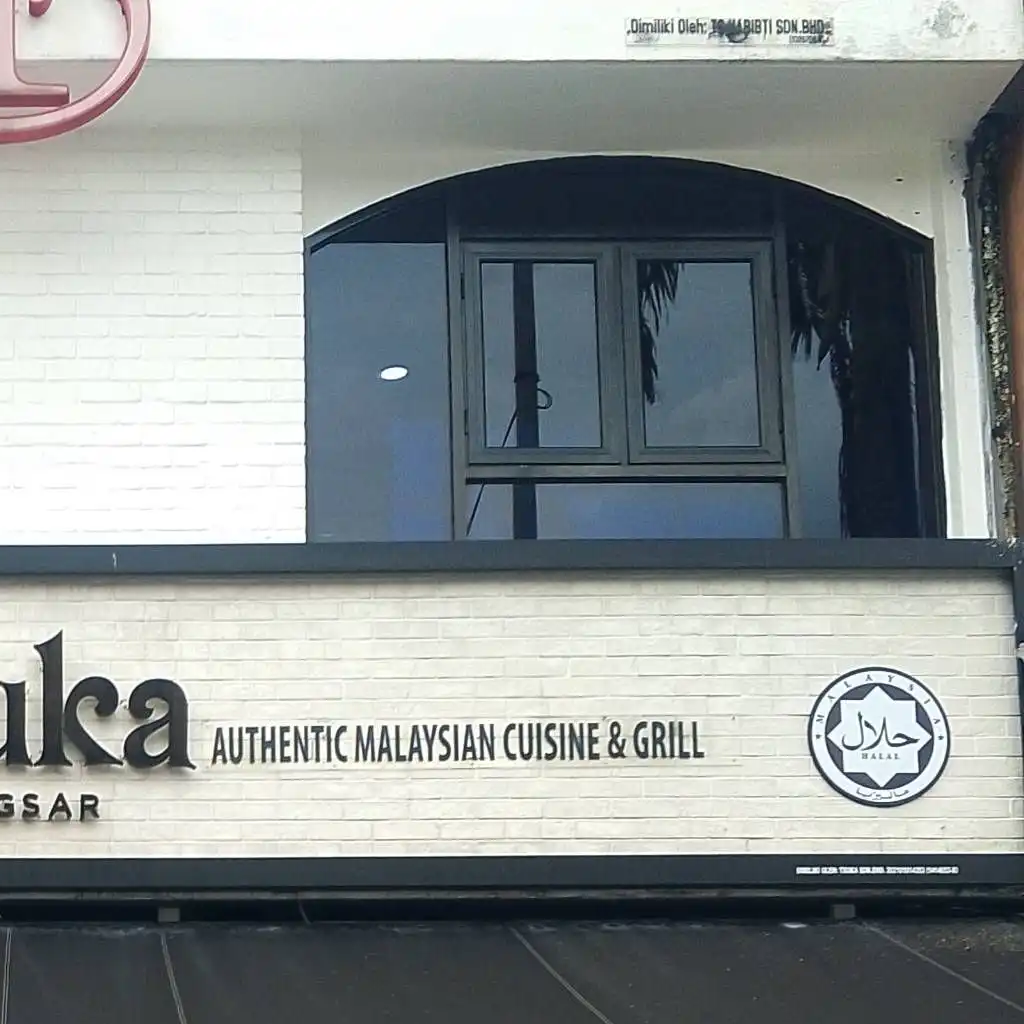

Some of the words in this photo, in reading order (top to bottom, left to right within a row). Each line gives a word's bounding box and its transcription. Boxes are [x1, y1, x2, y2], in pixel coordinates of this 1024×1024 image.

[630, 18, 675, 35] Dimiliki
[678, 18, 707, 35] Oleh:
[815, 674, 941, 725] MALAYSIA
[211, 725, 348, 765] AUTHENTIC
[354, 723, 495, 763] MALAYSIAN
[503, 722, 600, 762] CUISINE
[607, 721, 627, 760] &
[632, 720, 705, 760] GRILL
[861, 752, 900, 760] HALAL
